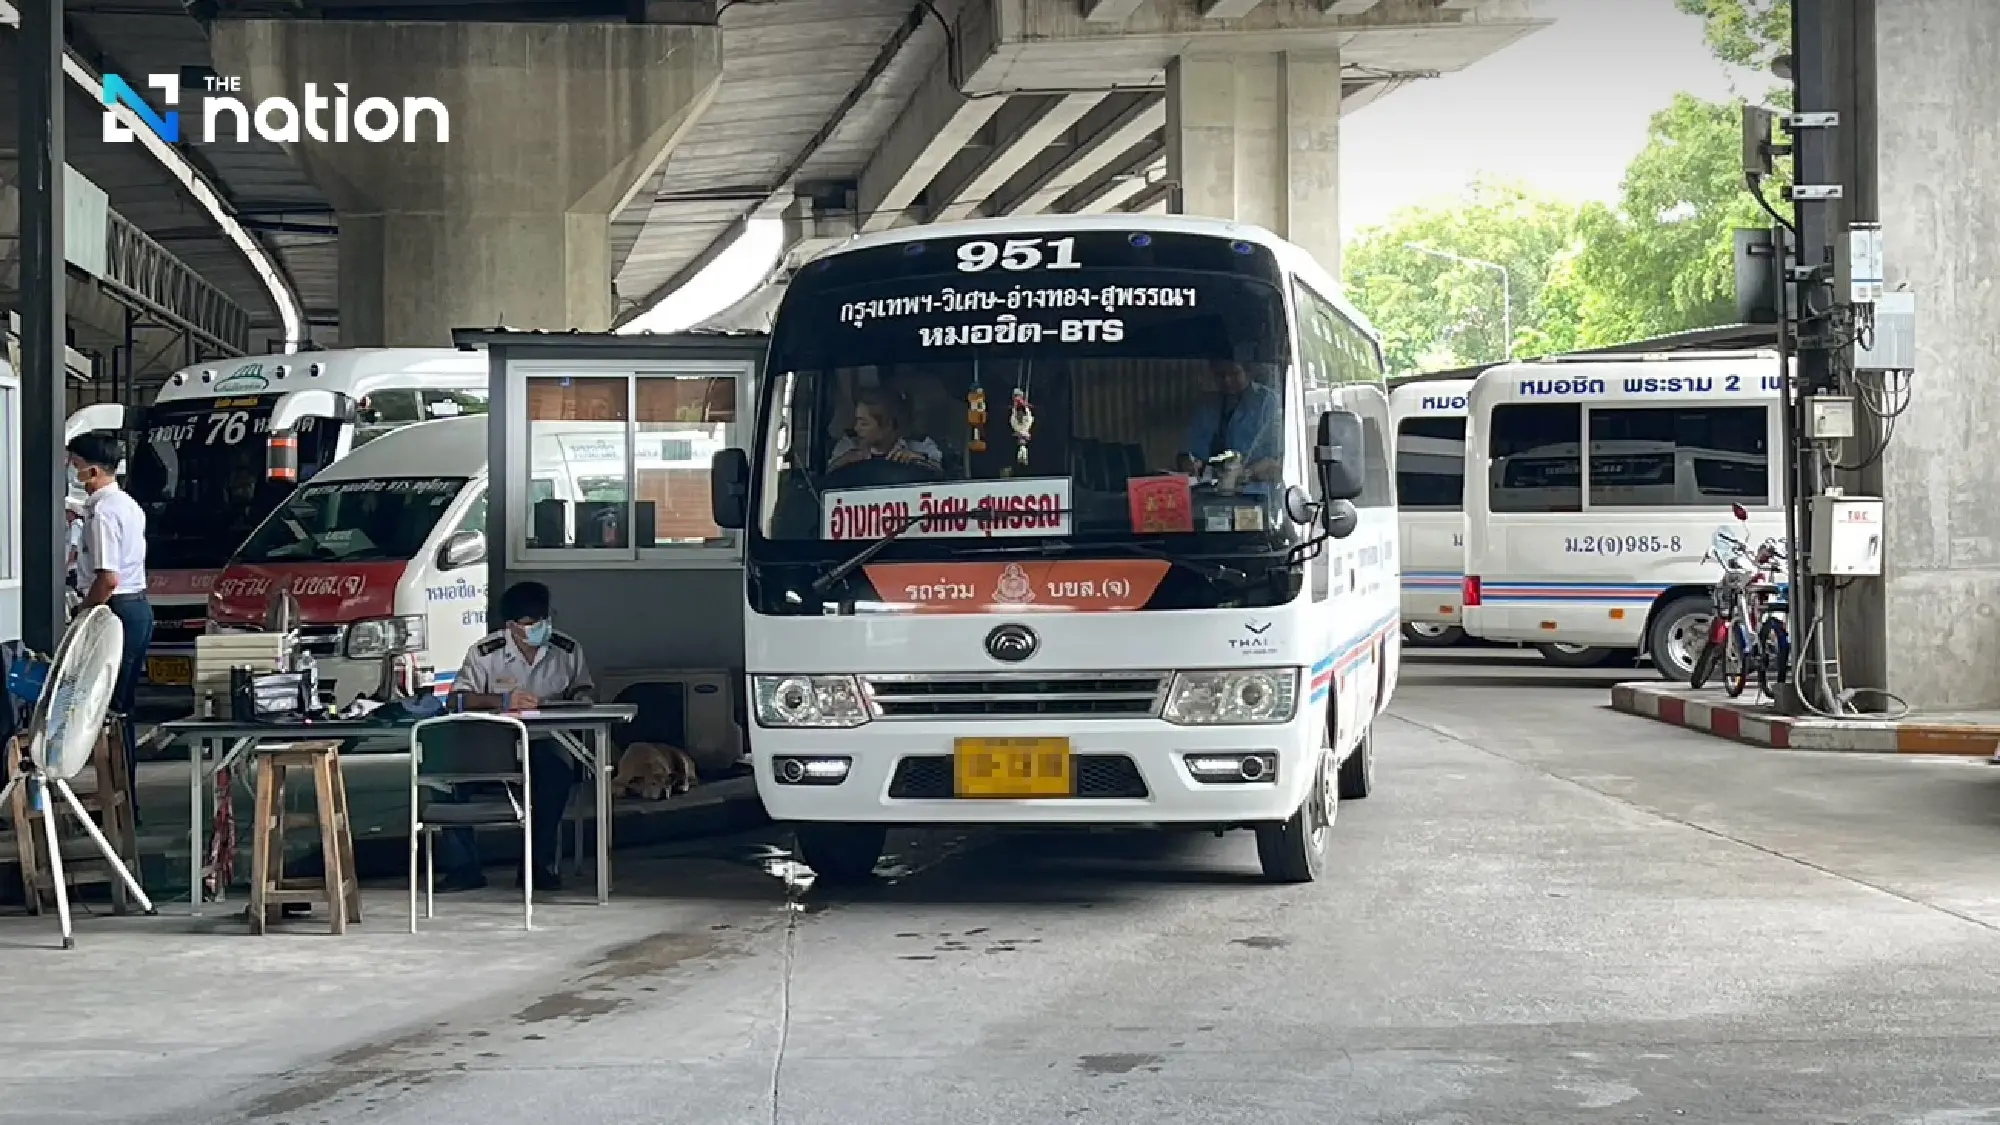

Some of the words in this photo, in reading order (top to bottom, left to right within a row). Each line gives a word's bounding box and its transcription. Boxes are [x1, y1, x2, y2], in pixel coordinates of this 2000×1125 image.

[956, 236, 1082, 272] 951
[840, 284, 1196, 328] กรุงเทพฯ-วิเศษ-อ่างทอง-สุพรรณฯ
[919, 314, 1124, 347] หมอชิต-BTS
[1520, 376, 1606, 395] หมอชิต
[1623, 376, 1713, 393] พระราม
[1725, 375, 1741, 392] 2
[1422, 396, 1470, 409] หมอ
[205, 410, 250, 445] 76
[905, 578, 974, 600] รถร่วม
[1048, 578, 1130, 599] บขส.(จ)
